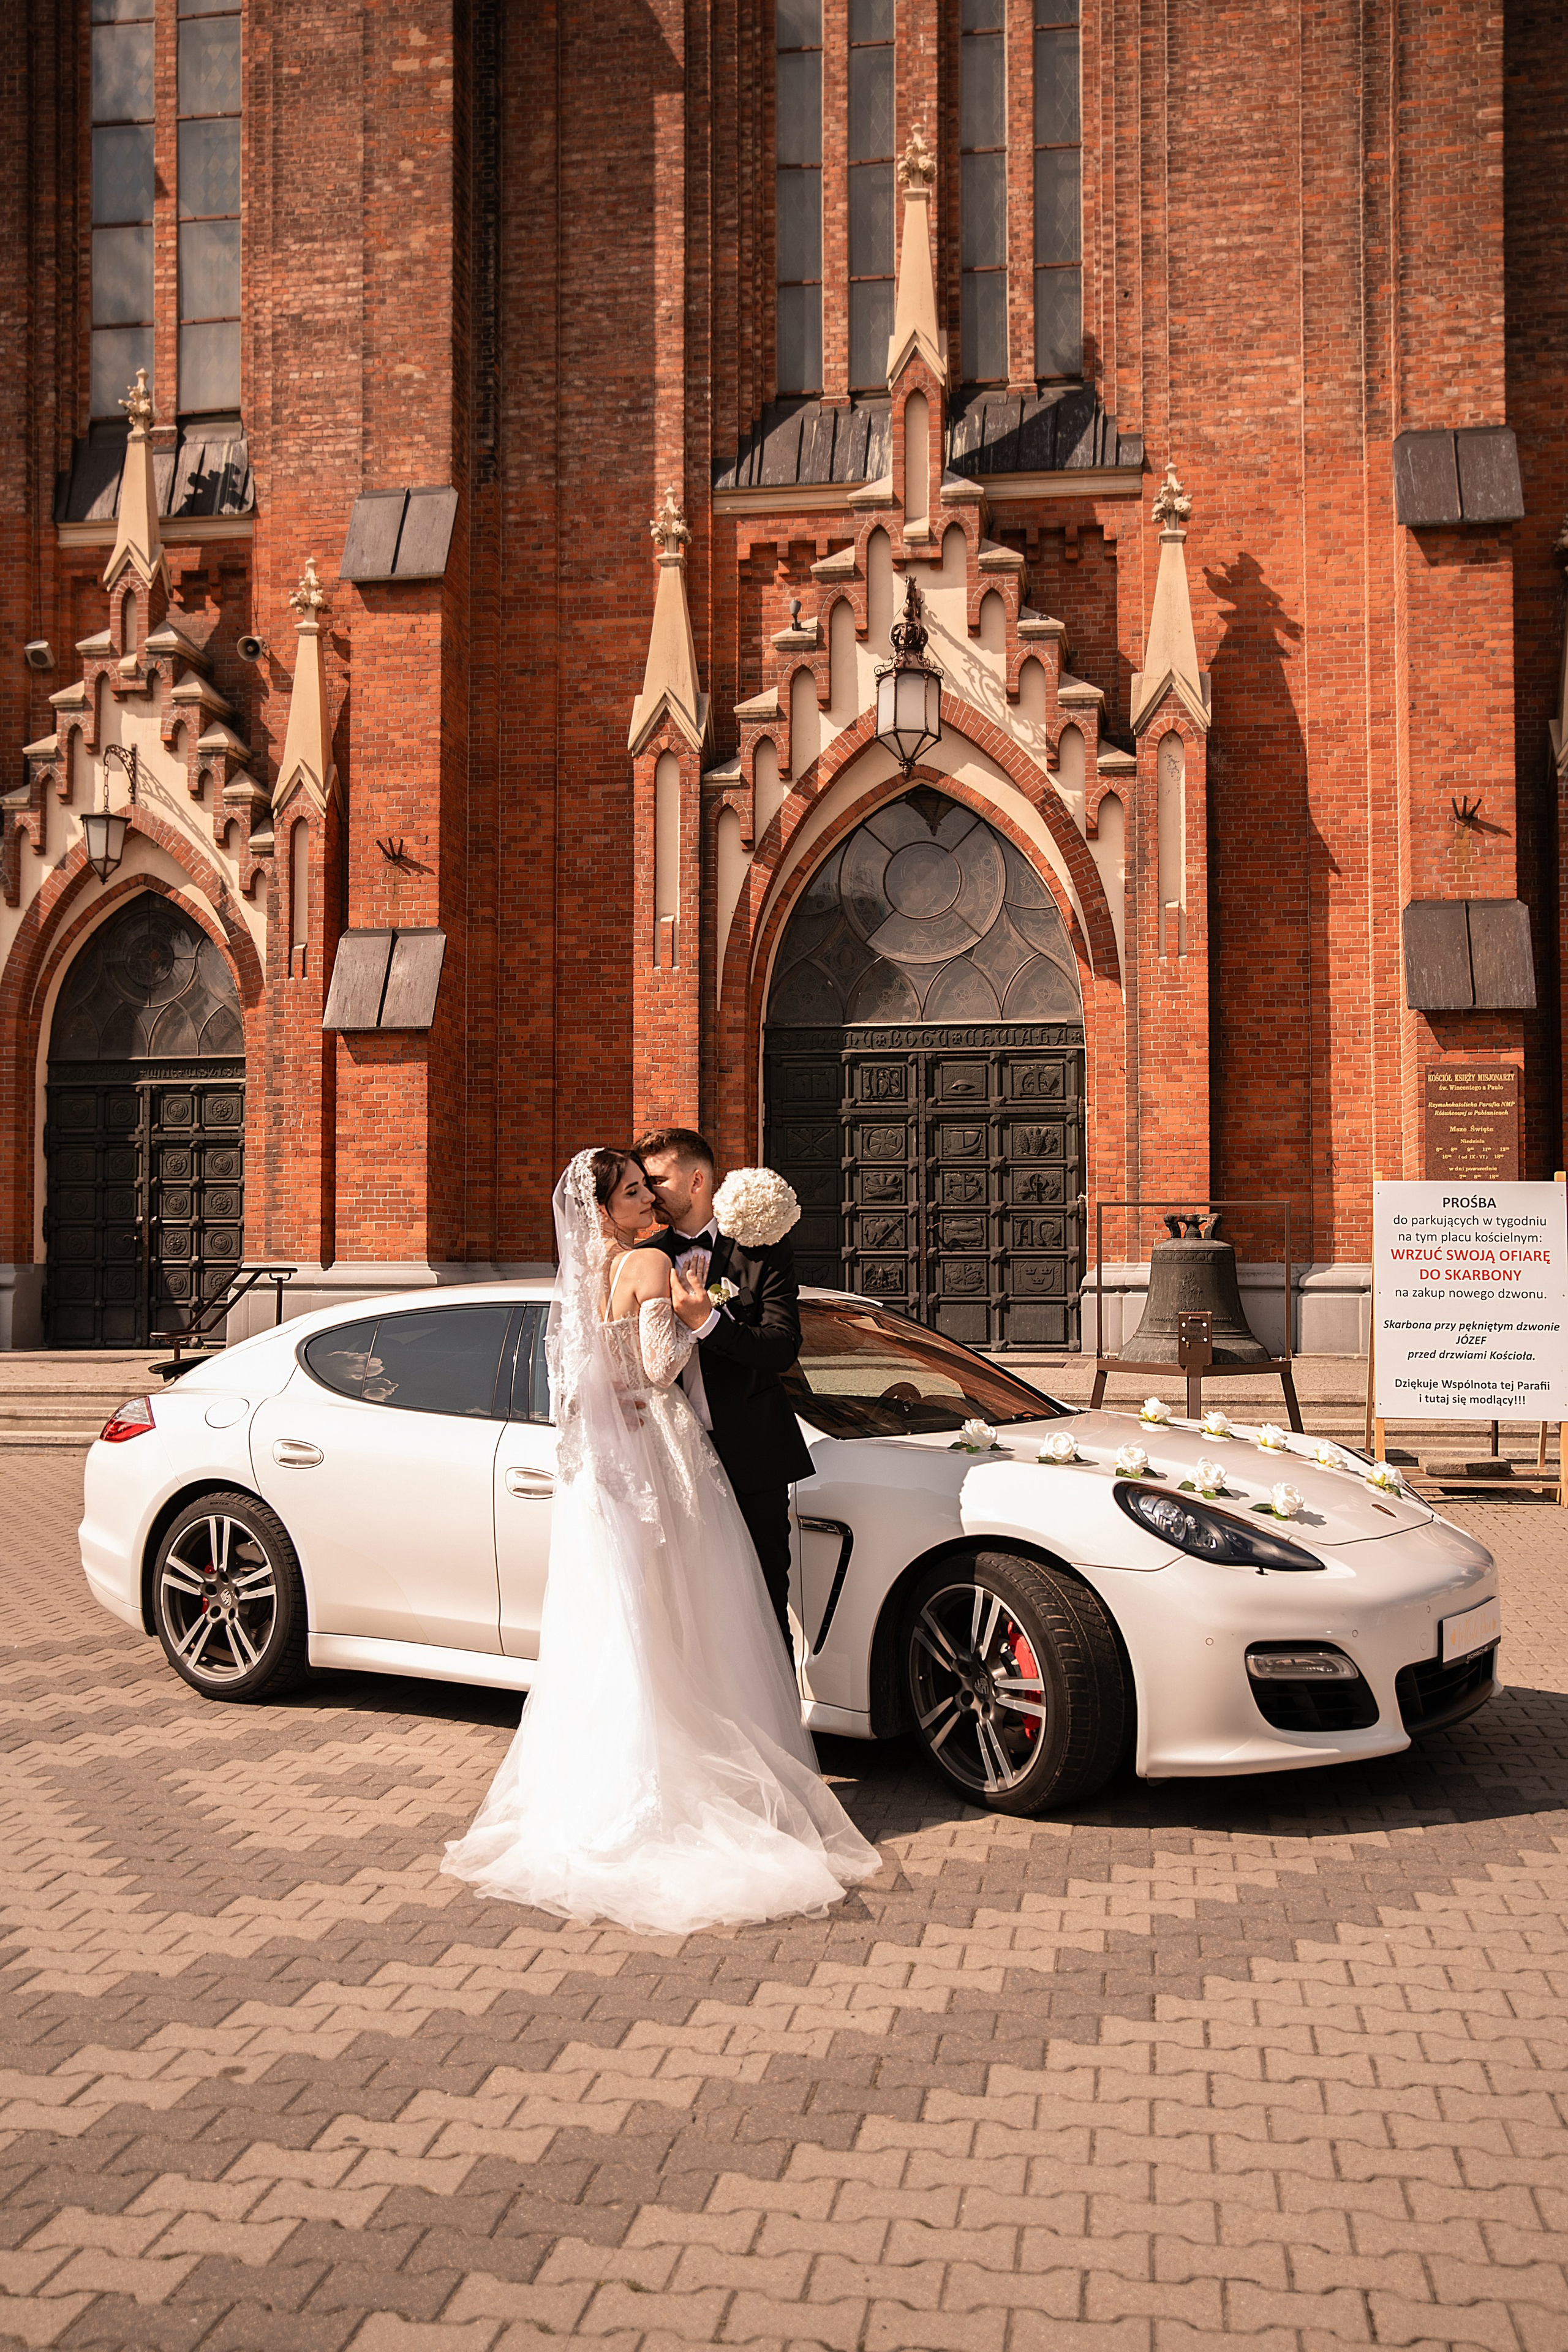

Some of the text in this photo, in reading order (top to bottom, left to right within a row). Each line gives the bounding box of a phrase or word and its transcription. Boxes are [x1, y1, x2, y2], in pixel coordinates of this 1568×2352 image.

[1428, 1072, 1452, 1082] KOŚCIÓŁ
[1455, 1072, 1476, 1083] KSIĘŻY
[1442, 1195, 1497, 1208] PROŚBA
[1393, 1214, 1408, 1225] do
[1411, 1215, 1479, 1227] parkujących
[1496, 1215, 1547, 1228] tygodniu
[1415, 1232, 1438, 1244] tym
[1441, 1231, 1471, 1244] placu
[1475, 1232, 1542, 1245] kościelnym:
[1390, 1246, 1551, 1265] WRZUĆ SWOJĄ OFIARĘ
[1420, 1268, 1522, 1281] DO SKARBONY
[1412, 1287, 1446, 1300] zakup
[1449, 1290, 1494, 1301] nowego
[1498, 1288, 1547, 1299] dzwonu.
[1383, 1319, 1560, 1333] Skarbona przy pękniętym dzwonie
[1455, 1333, 1487, 1345] JÓZEF
[1407, 1349, 1536, 1360] przed drzwiami Kościoła.
[1395, 1378, 1550, 1392] Dziękuje Wspólnota tej Parafii
[1419, 1393, 1526, 1407] i tutaj się modlący!!!
[1466, 1645, 1489, 1660] PORSCHE
